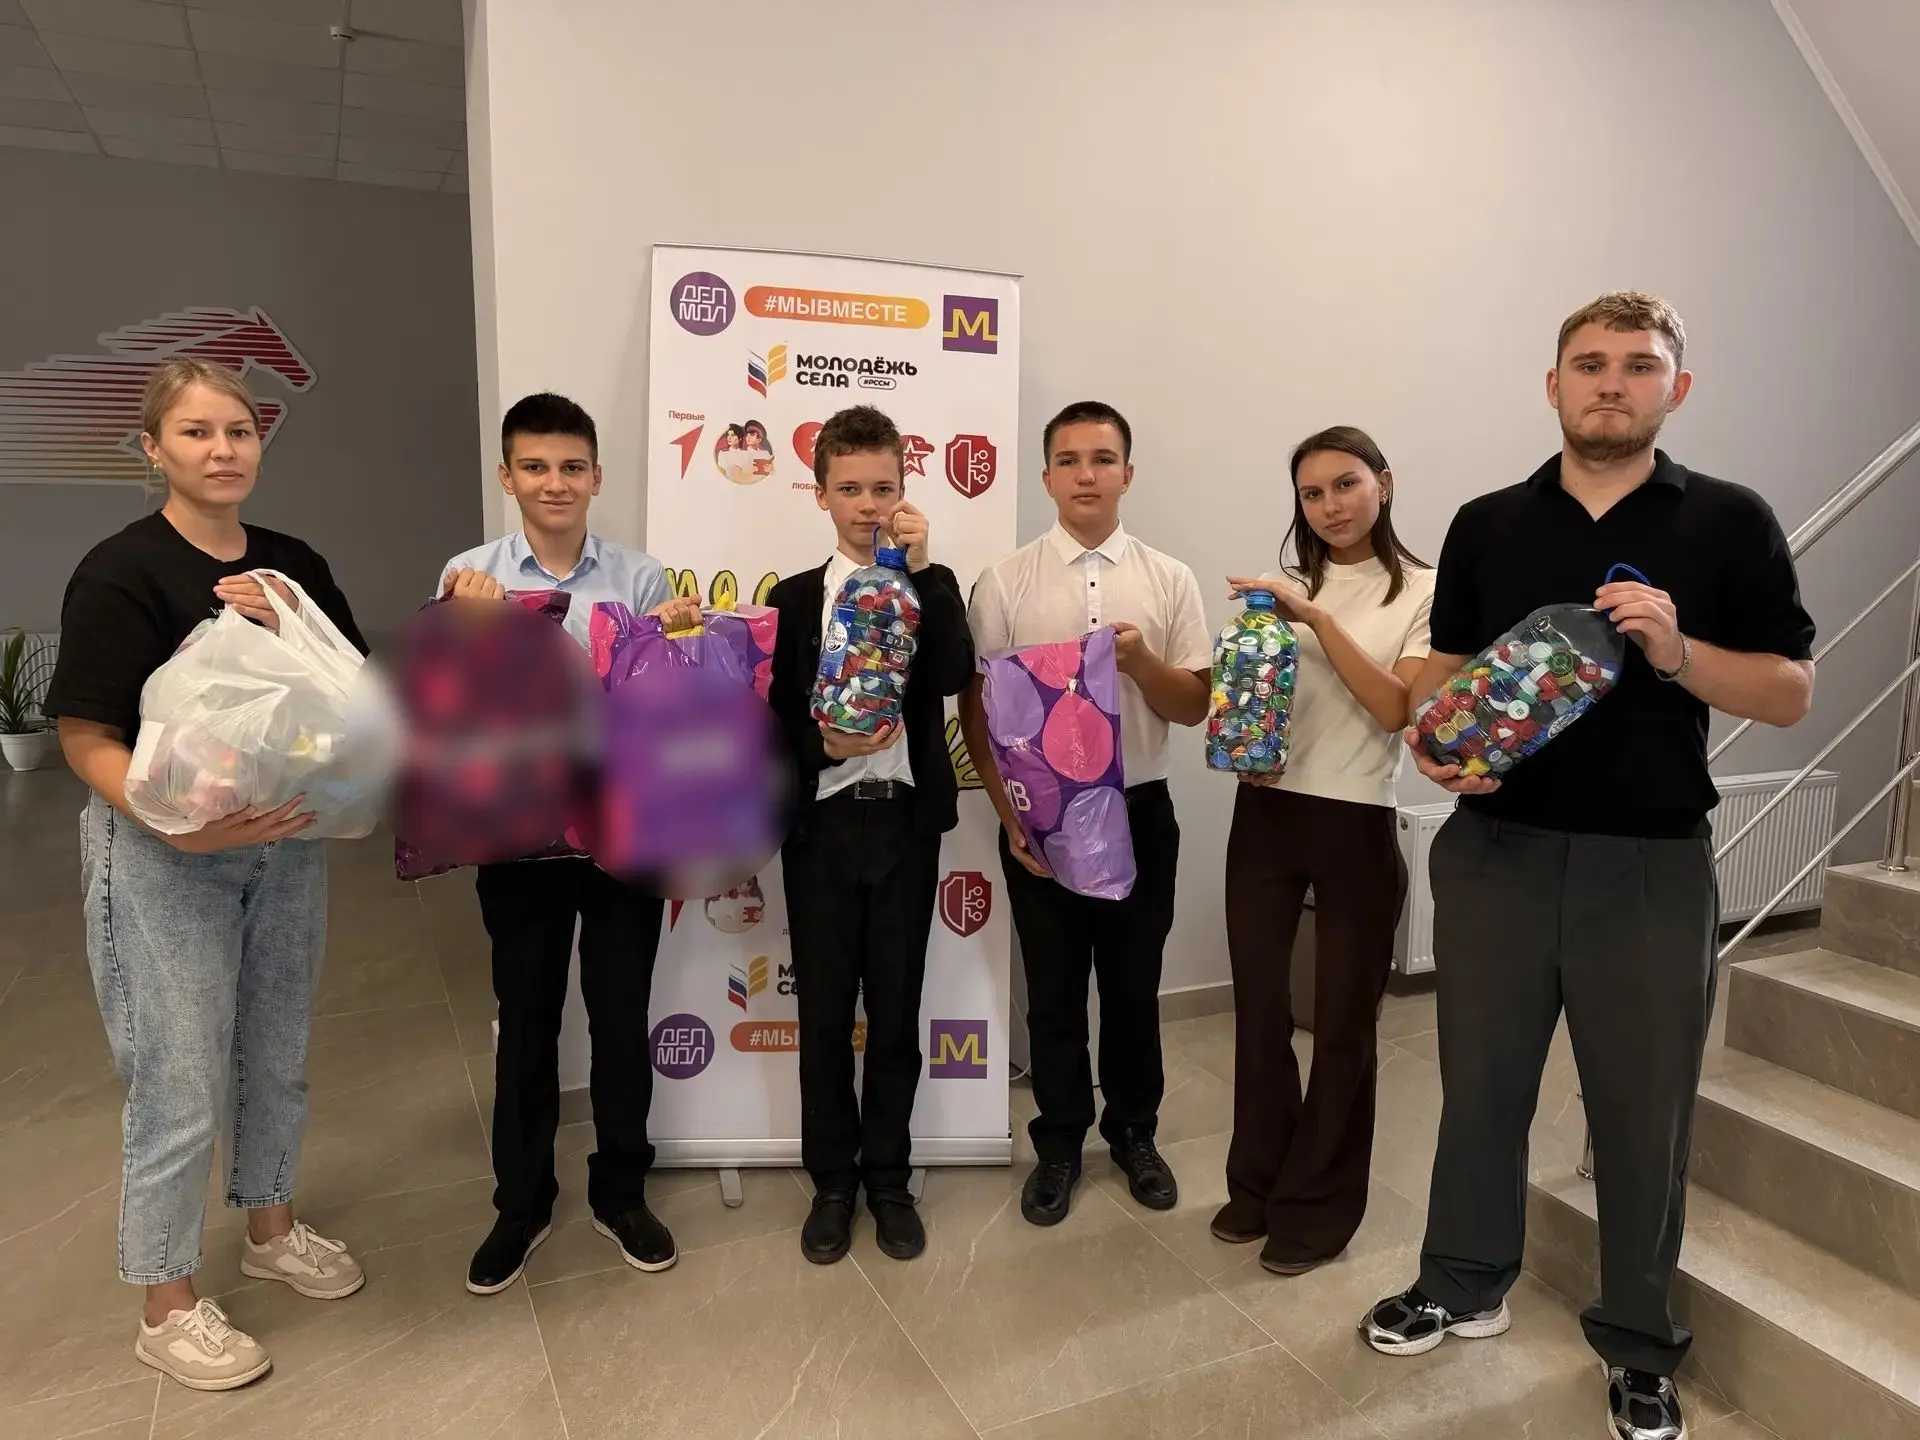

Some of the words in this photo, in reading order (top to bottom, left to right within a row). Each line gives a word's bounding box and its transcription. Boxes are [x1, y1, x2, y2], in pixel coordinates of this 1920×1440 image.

[680, 303, 727, 324] МОЛ
[764, 295, 907, 323] #МЫВМЕСТЕ
[796, 354, 918, 376] МОЛОДЁЖЬ
[796, 371, 849, 388] СЕЛА
[668, 410, 706, 421] Первые
[656, 1046, 706, 1065] МОЛ
